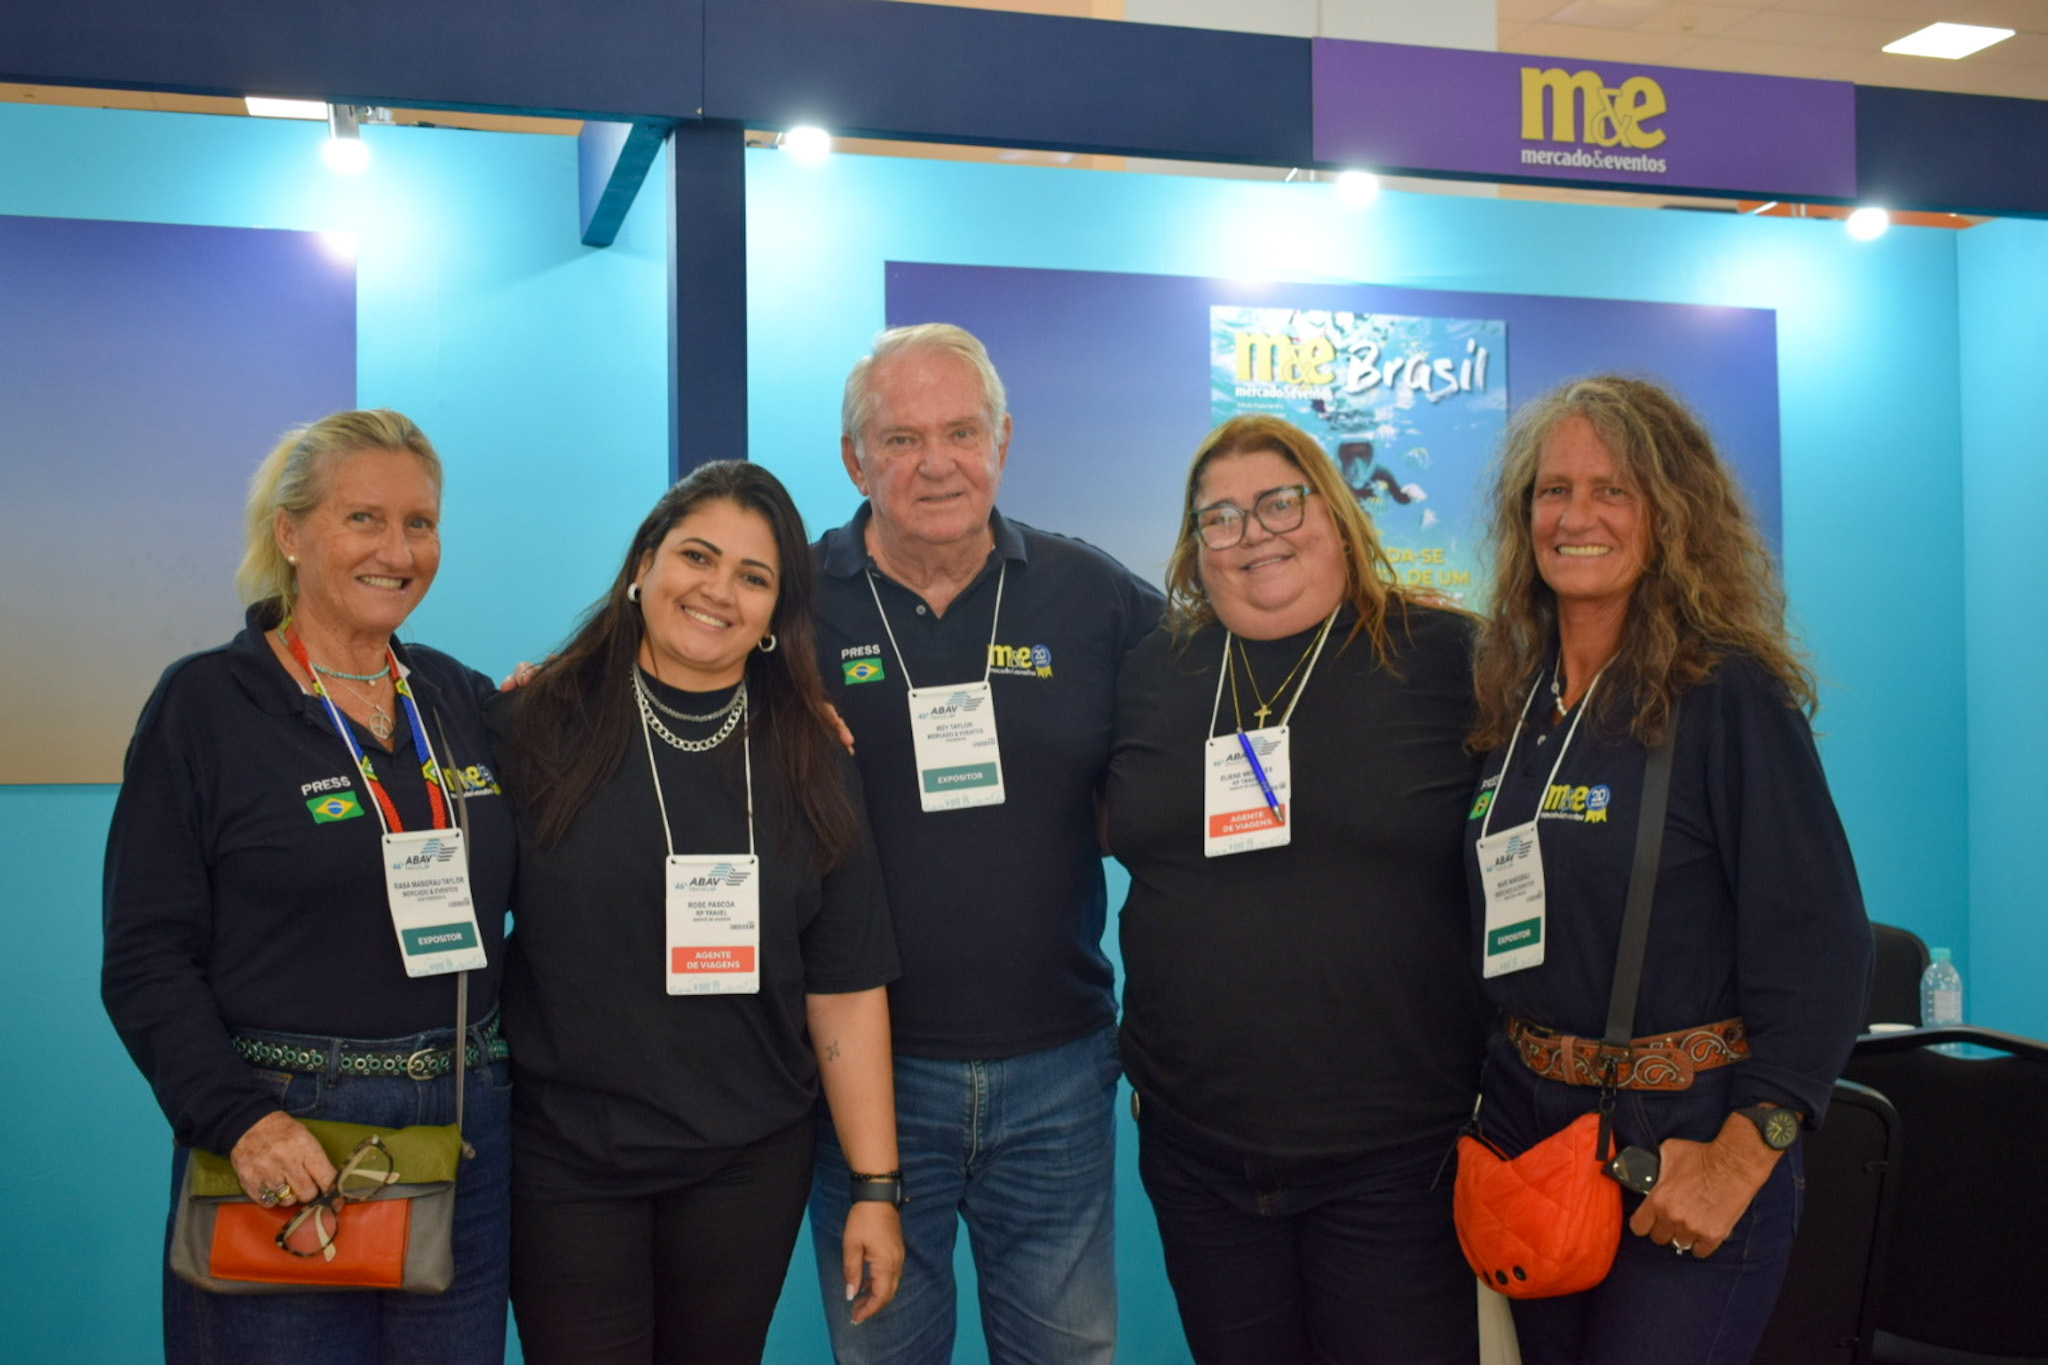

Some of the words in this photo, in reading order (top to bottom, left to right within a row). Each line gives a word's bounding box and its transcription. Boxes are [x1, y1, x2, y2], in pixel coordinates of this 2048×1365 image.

[1521, 67, 1667, 149] m&e
[1521, 148, 1667, 173] mercado&eventos
[1235, 332, 1336, 386] m&e
[1345, 338, 1488, 403] Brasil
[1384, 547, 1446, 565] DA-SE
[1407, 568, 1434, 586] DE
[1440, 569, 1471, 586] UM
[841, 644, 881, 659] PRESS
[931, 705, 958, 715] ABAV
[1225, 751, 1249, 761] ABA
[937, 772, 983, 784] EXPOSITOR
[301, 776, 351, 796] PRESS
[1592, 789, 1606, 801] 20
[1230, 811, 1264, 823] AGENTE
[1223, 825, 1233, 833] DE
[1235, 818, 1273, 831] VIAGENS
[405, 855, 432, 865] ABAV
[442, 876, 465, 885] TAYLOR
[688, 877, 721, 886] ABAV
[402, 889, 429, 898] MERCADO
[434, 886, 459, 895] EVENTOS
[708, 900, 735, 908] PASCOA
[418, 932, 463, 946] EXPOSITOR
[1497, 929, 1531, 945] EXPOSITOR
[695, 951, 732, 959] AGENTE
[687, 961, 700, 969] DE
[701, 960, 741, 969] VIAGENS
